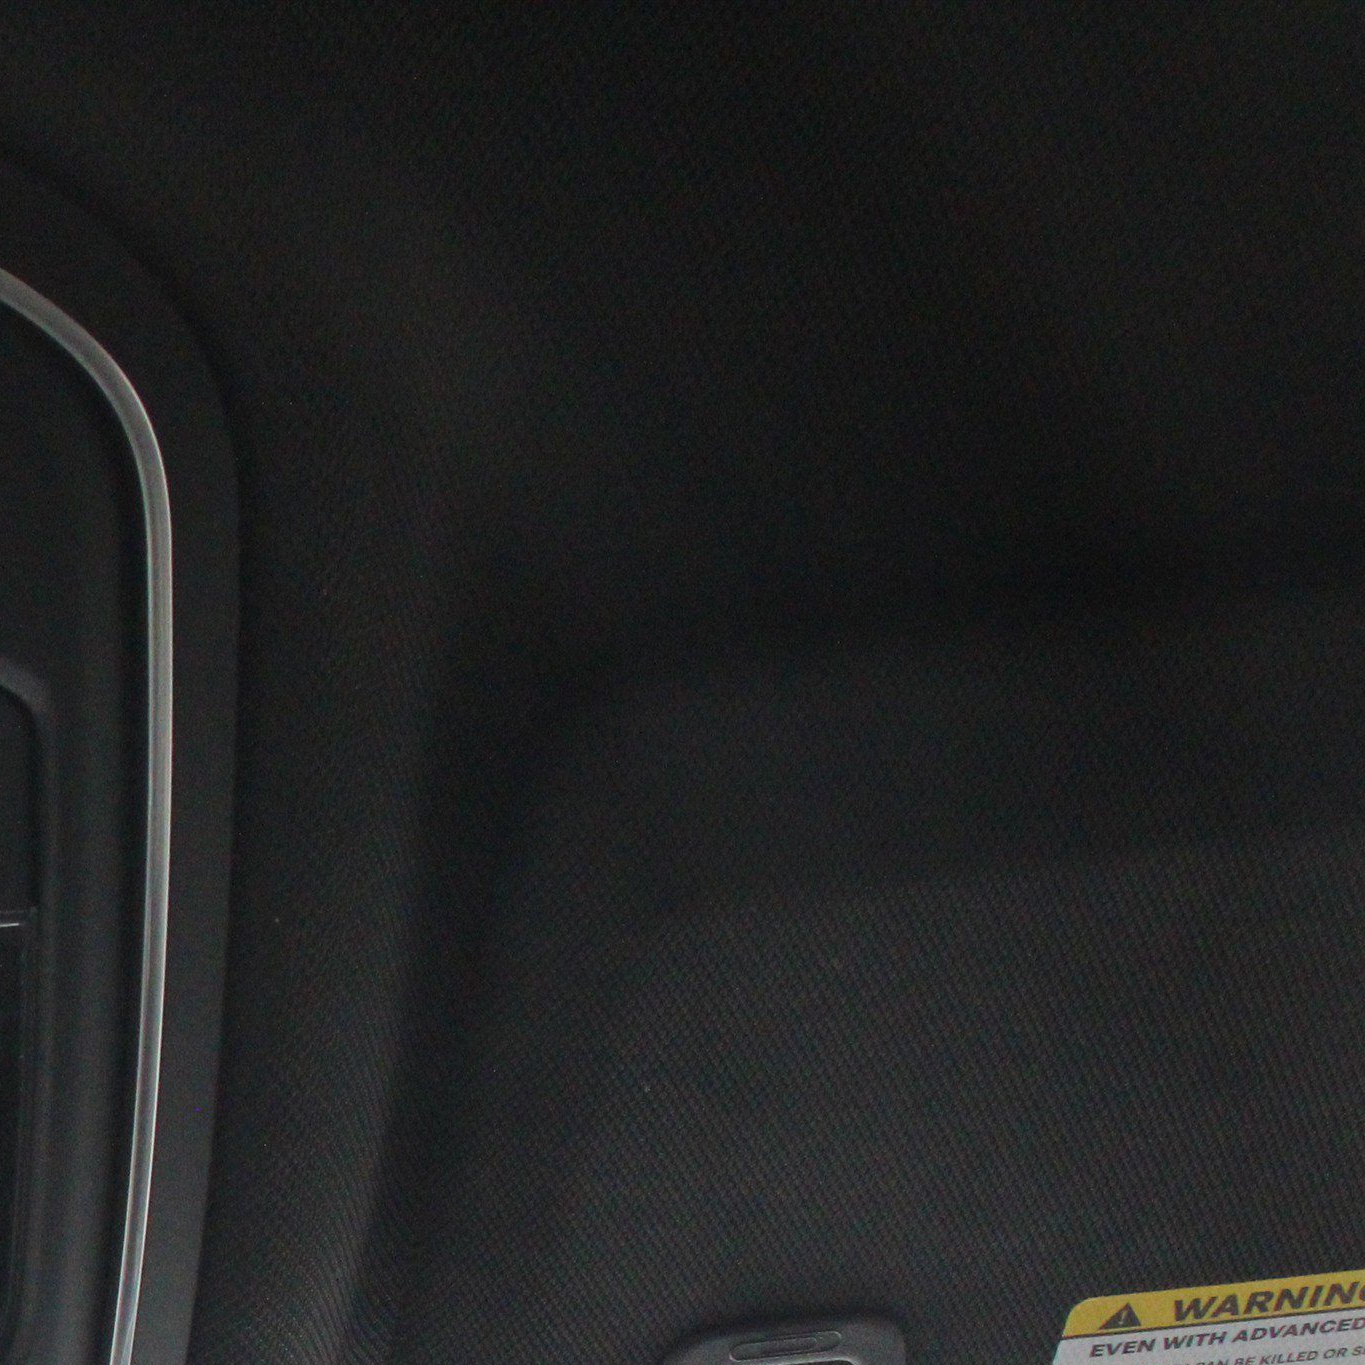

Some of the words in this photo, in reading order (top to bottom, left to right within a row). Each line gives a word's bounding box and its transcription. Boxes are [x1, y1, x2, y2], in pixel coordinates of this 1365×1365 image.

[1173, 1281, 1365, 1322] WARNIN
[1089, 1339, 1156, 1358] EVEN
[1164, 1331, 1227, 1350] WITH
[1231, 1317, 1365, 1343] ADVANCED
[1259, 1351, 1318, 1365] KILLED
[1323, 1347, 1348, 1360] OR
